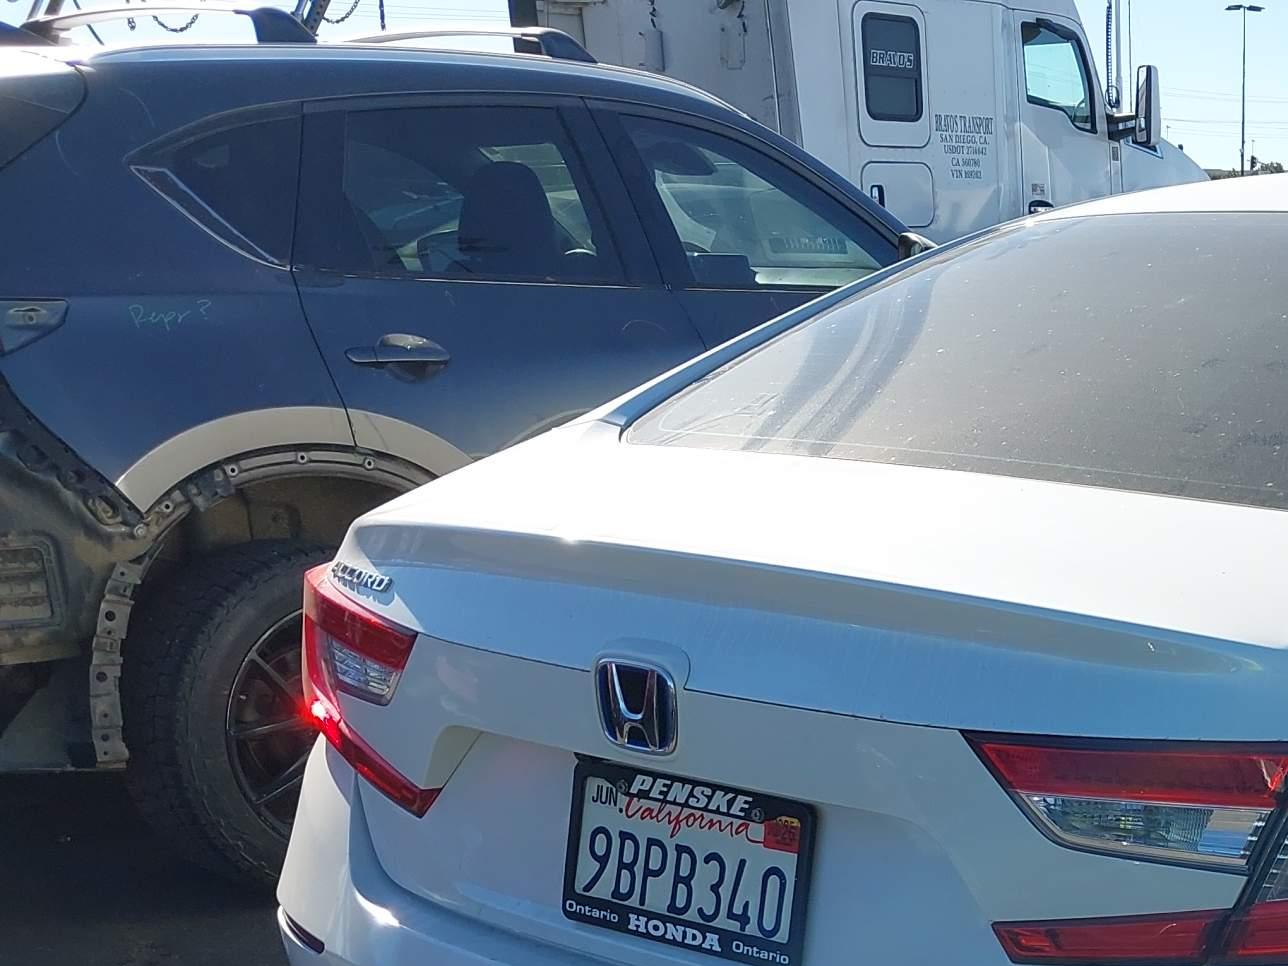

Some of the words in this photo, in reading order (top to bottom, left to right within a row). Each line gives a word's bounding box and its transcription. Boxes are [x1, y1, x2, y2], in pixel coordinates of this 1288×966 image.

[934, 114, 959, 133] BRAVOS
[959, 115, 993, 135] TRANSPORT
[940, 134, 954, 144] SAN
[943, 145, 965, 155] USDOT
[951, 157, 961, 167] CA
[950, 169, 963, 179] VIN
[332, 561, 392, 593] ACCORD
[592, 784, 618, 807] JUN
[629, 774, 753, 817] PENSKE
[624, 796, 762, 843] California
[582, 826, 787, 939] 9BPB340
[565, 900, 619, 922] Ontario
[627, 913, 722, 953] HONDA
[732, 940, 790, 965] Ontario
